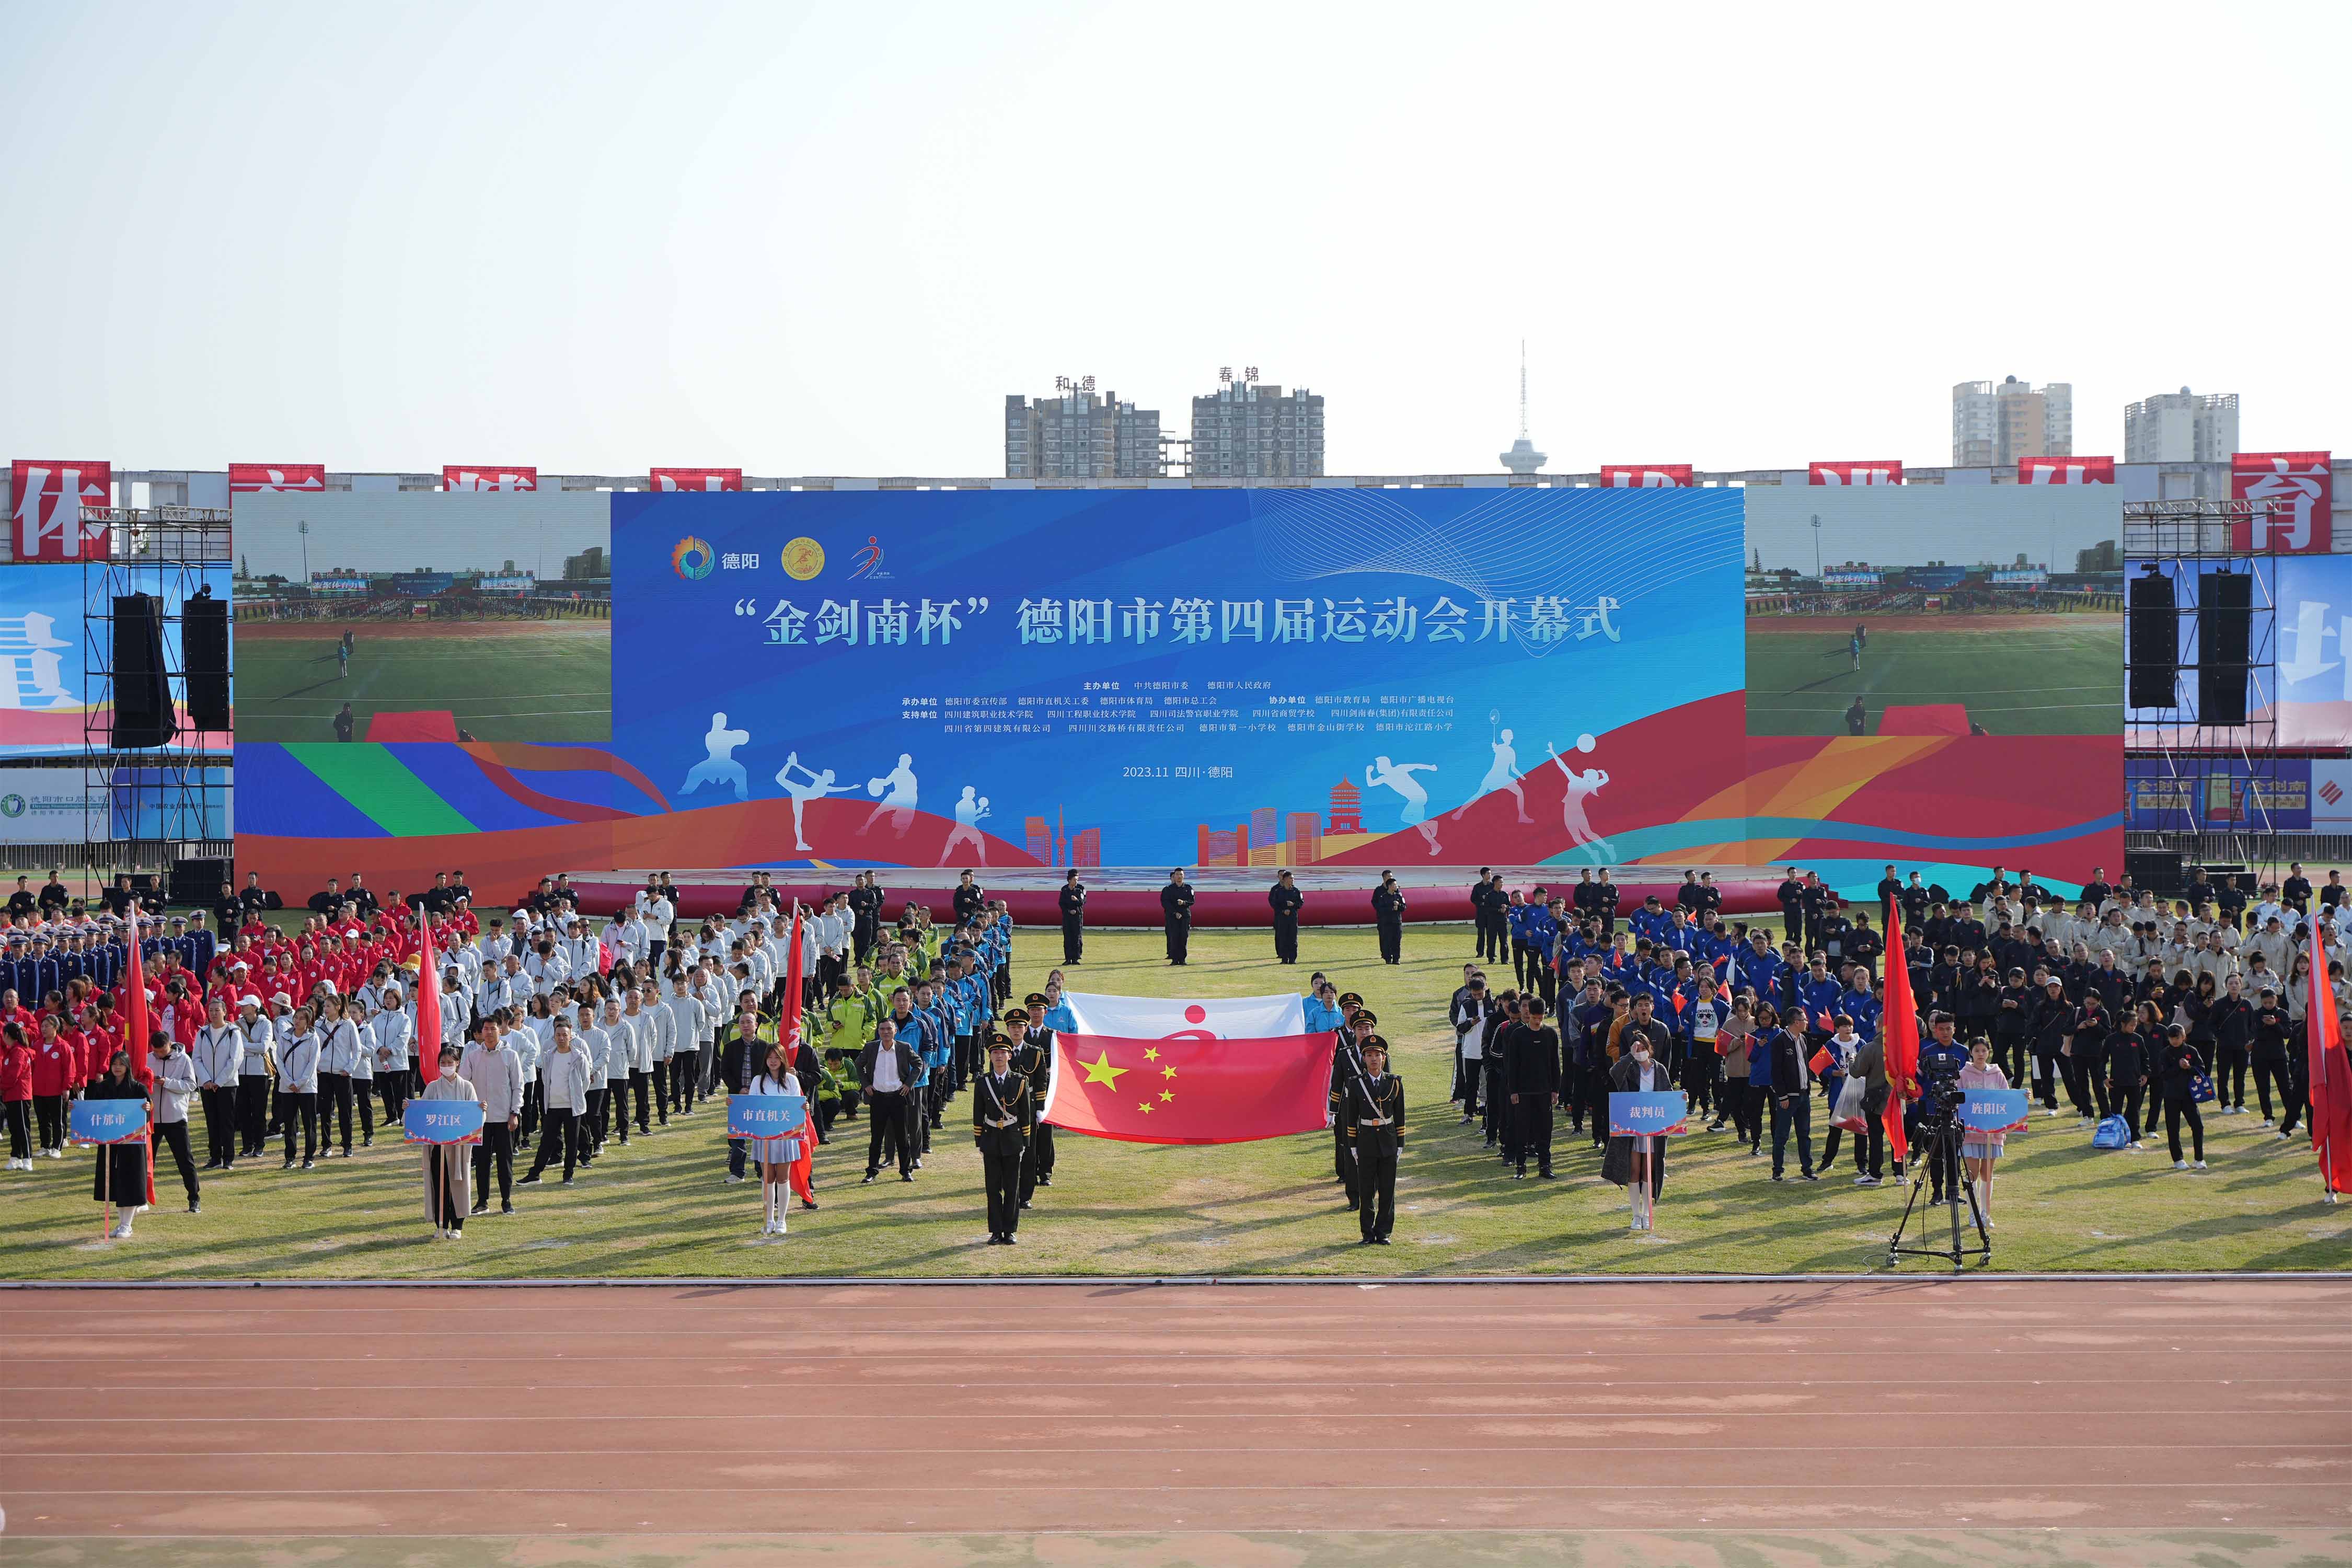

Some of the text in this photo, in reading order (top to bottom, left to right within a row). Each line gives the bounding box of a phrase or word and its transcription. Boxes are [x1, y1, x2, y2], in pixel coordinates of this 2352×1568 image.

[1219, 366, 1258, 382] 春锦
[1056, 375, 1095, 391] 和德
[721, 553, 759, 569] 德阳
[735, 596, 1621, 645] “金剑南杯” 德阳市第四届运动会开幕式
[1083, 681, 1271, 690] 主办单位 中共德阳市委 德阳市人民政府
[902, 696, 1217, 706] 承办单位 德阳市委宣传部 德阳市直机关工委 德阳市体育局 德阳市总工会
[1269, 695, 1455, 705] 协办单位 德阳市教育局 德阳市广播电视台
[902, 710, 938, 719] 支持单位
[944, 710, 1033, 719] 四川建筑职业技术学院
[1047, 710, 1136, 719] 四川工程职业技术学院
[1150, 709, 1239, 719] 四川司法警官职业学院
[1253, 709, 1315, 718] 四川省商贸学校
[944, 723, 1453, 733] 四川省第四建筑有限公司 四川川交路桥有限责任公司 德阳市第一小学校 德阳市金山街学校 德阳市沱江路小学
[1123, 766, 1233, 778] 2023.11 四川·德阳
[1630, 1106, 1665, 1118] 裁判员
[1971, 1102, 2007, 1114] 旌阳区
[90, 1113, 126, 1126] 什邡市
[426, 1114, 462, 1126] 罗江区
[743, 1109, 790, 1122] 市直机关
